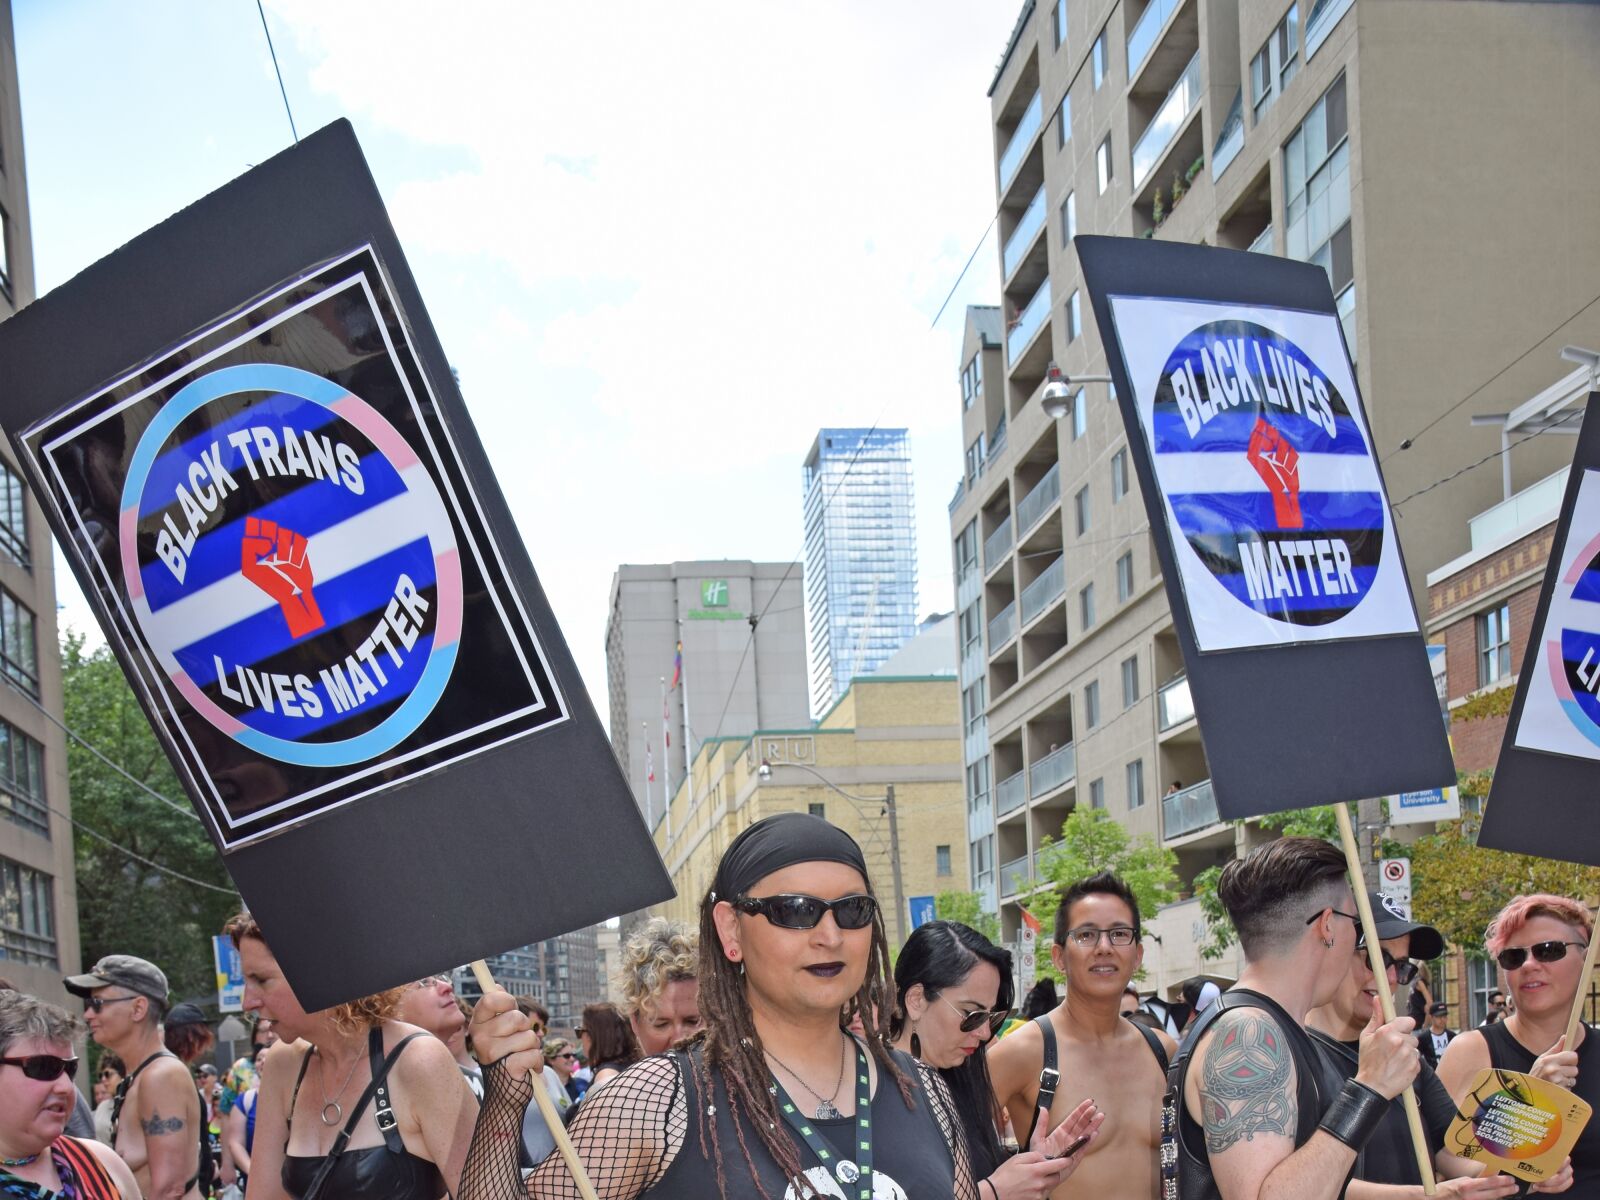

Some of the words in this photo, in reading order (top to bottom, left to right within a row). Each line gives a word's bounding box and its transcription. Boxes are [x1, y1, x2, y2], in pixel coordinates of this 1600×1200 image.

[1170, 338, 1260, 439] BLACK
[1252, 339, 1337, 440] LIVES
[155, 440, 239, 586] BLACK
[227, 425, 365, 496] TRANS
[1238, 538, 1359, 601] MATTER
[213, 653, 324, 719] LIVES
[318, 573, 430, 715] MATTER
[1576, 646, 1600, 703] LI
[1402, 795, 1440, 805] University
[1484, 1113, 1495, 1121] LA
[1487, 1107, 1519, 1123] LUTTONS
[1519, 1119, 1550, 1134] CONTRE
[1495, 1095, 1527, 1110] LUTTONS
[1526, 1106, 1557, 1120] CONTRE
[1477, 1125, 1493, 1135] LES
[1492, 1130, 1514, 1142] FRAIS
[1480, 1120, 1513, 1136] LUTTONS
[1512, 1132, 1542, 1146] CONTRE
